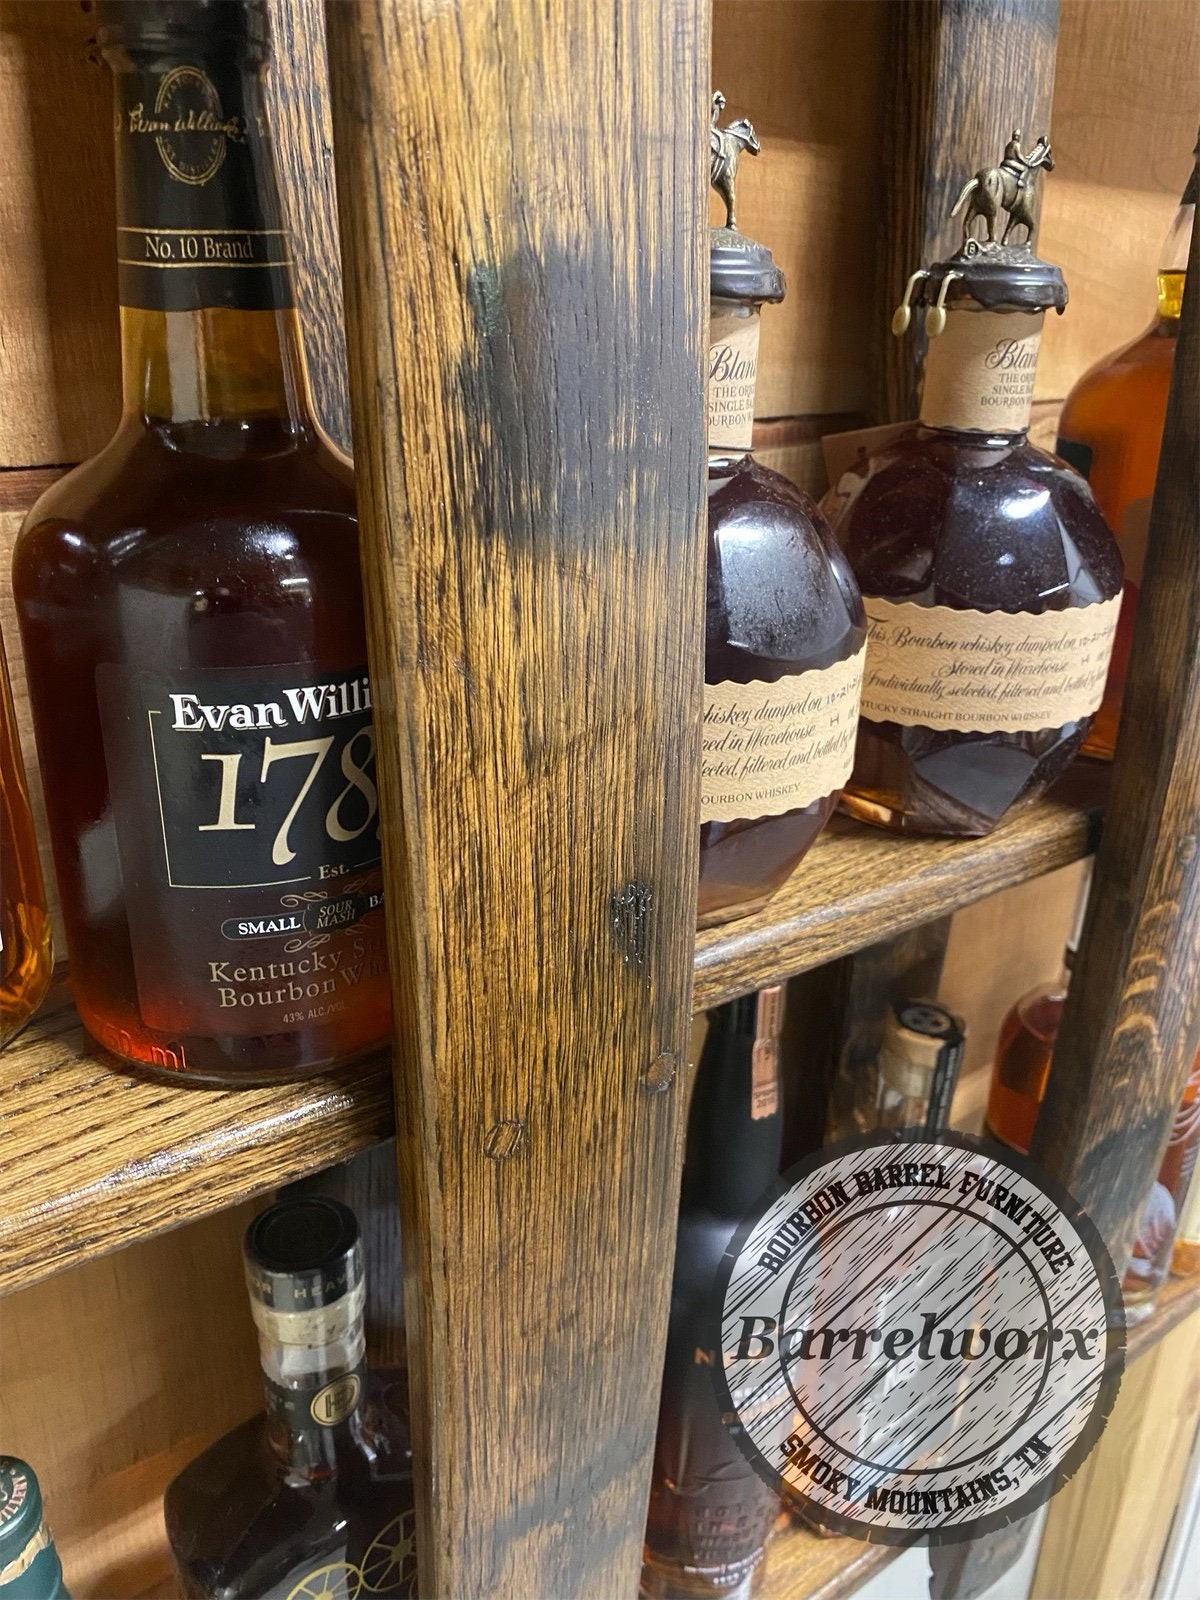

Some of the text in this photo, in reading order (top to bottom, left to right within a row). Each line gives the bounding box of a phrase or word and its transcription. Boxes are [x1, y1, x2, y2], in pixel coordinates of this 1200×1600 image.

[145, 234, 254, 259] No. 10 Brand
[998, 372, 1019, 384] THE
[712, 386, 737, 398] THE
[991, 384, 1025, 395] SINGLE
[708, 398, 745, 412] SINGLE
[889, 626, 959, 650] Bourbon
[959, 634, 1015, 660] whiskey
[1015, 631, 1068, 656] dumped
[931, 657, 995, 679] Stored
[990, 658, 1005, 676] in
[1004, 657, 1070, 679] Warehouse
[863, 669, 946, 701] Individually
[996, 679, 1047, 704] filtered
[169, 693, 289, 732] Evan
[753, 691, 812, 726] dumped
[809, 695, 823, 711] on
[900, 706, 954, 720] STRAIGHT
[954, 712, 1010, 721] BOURBON
[1010, 710, 1052, 721] WHISKEY
[728, 730, 744, 753] in
[744, 724, 817, 754] Warehouse
[829, 712, 840, 727] H
[738, 745, 791, 782] filtered
[788, 743, 815, 766] and
[198, 724, 381, 866] 178
[755, 782, 801, 801] WHISKEY
[318, 864, 350, 880] Est.
[316, 910, 356, 929] MASH
[319, 901, 353, 919] SOUR
[237, 916, 301, 935] SMALL
[207, 950, 342, 984] Kentucky
[218, 980, 337, 1008] Bourbon
[283, 1010, 305, 1024] 43%
